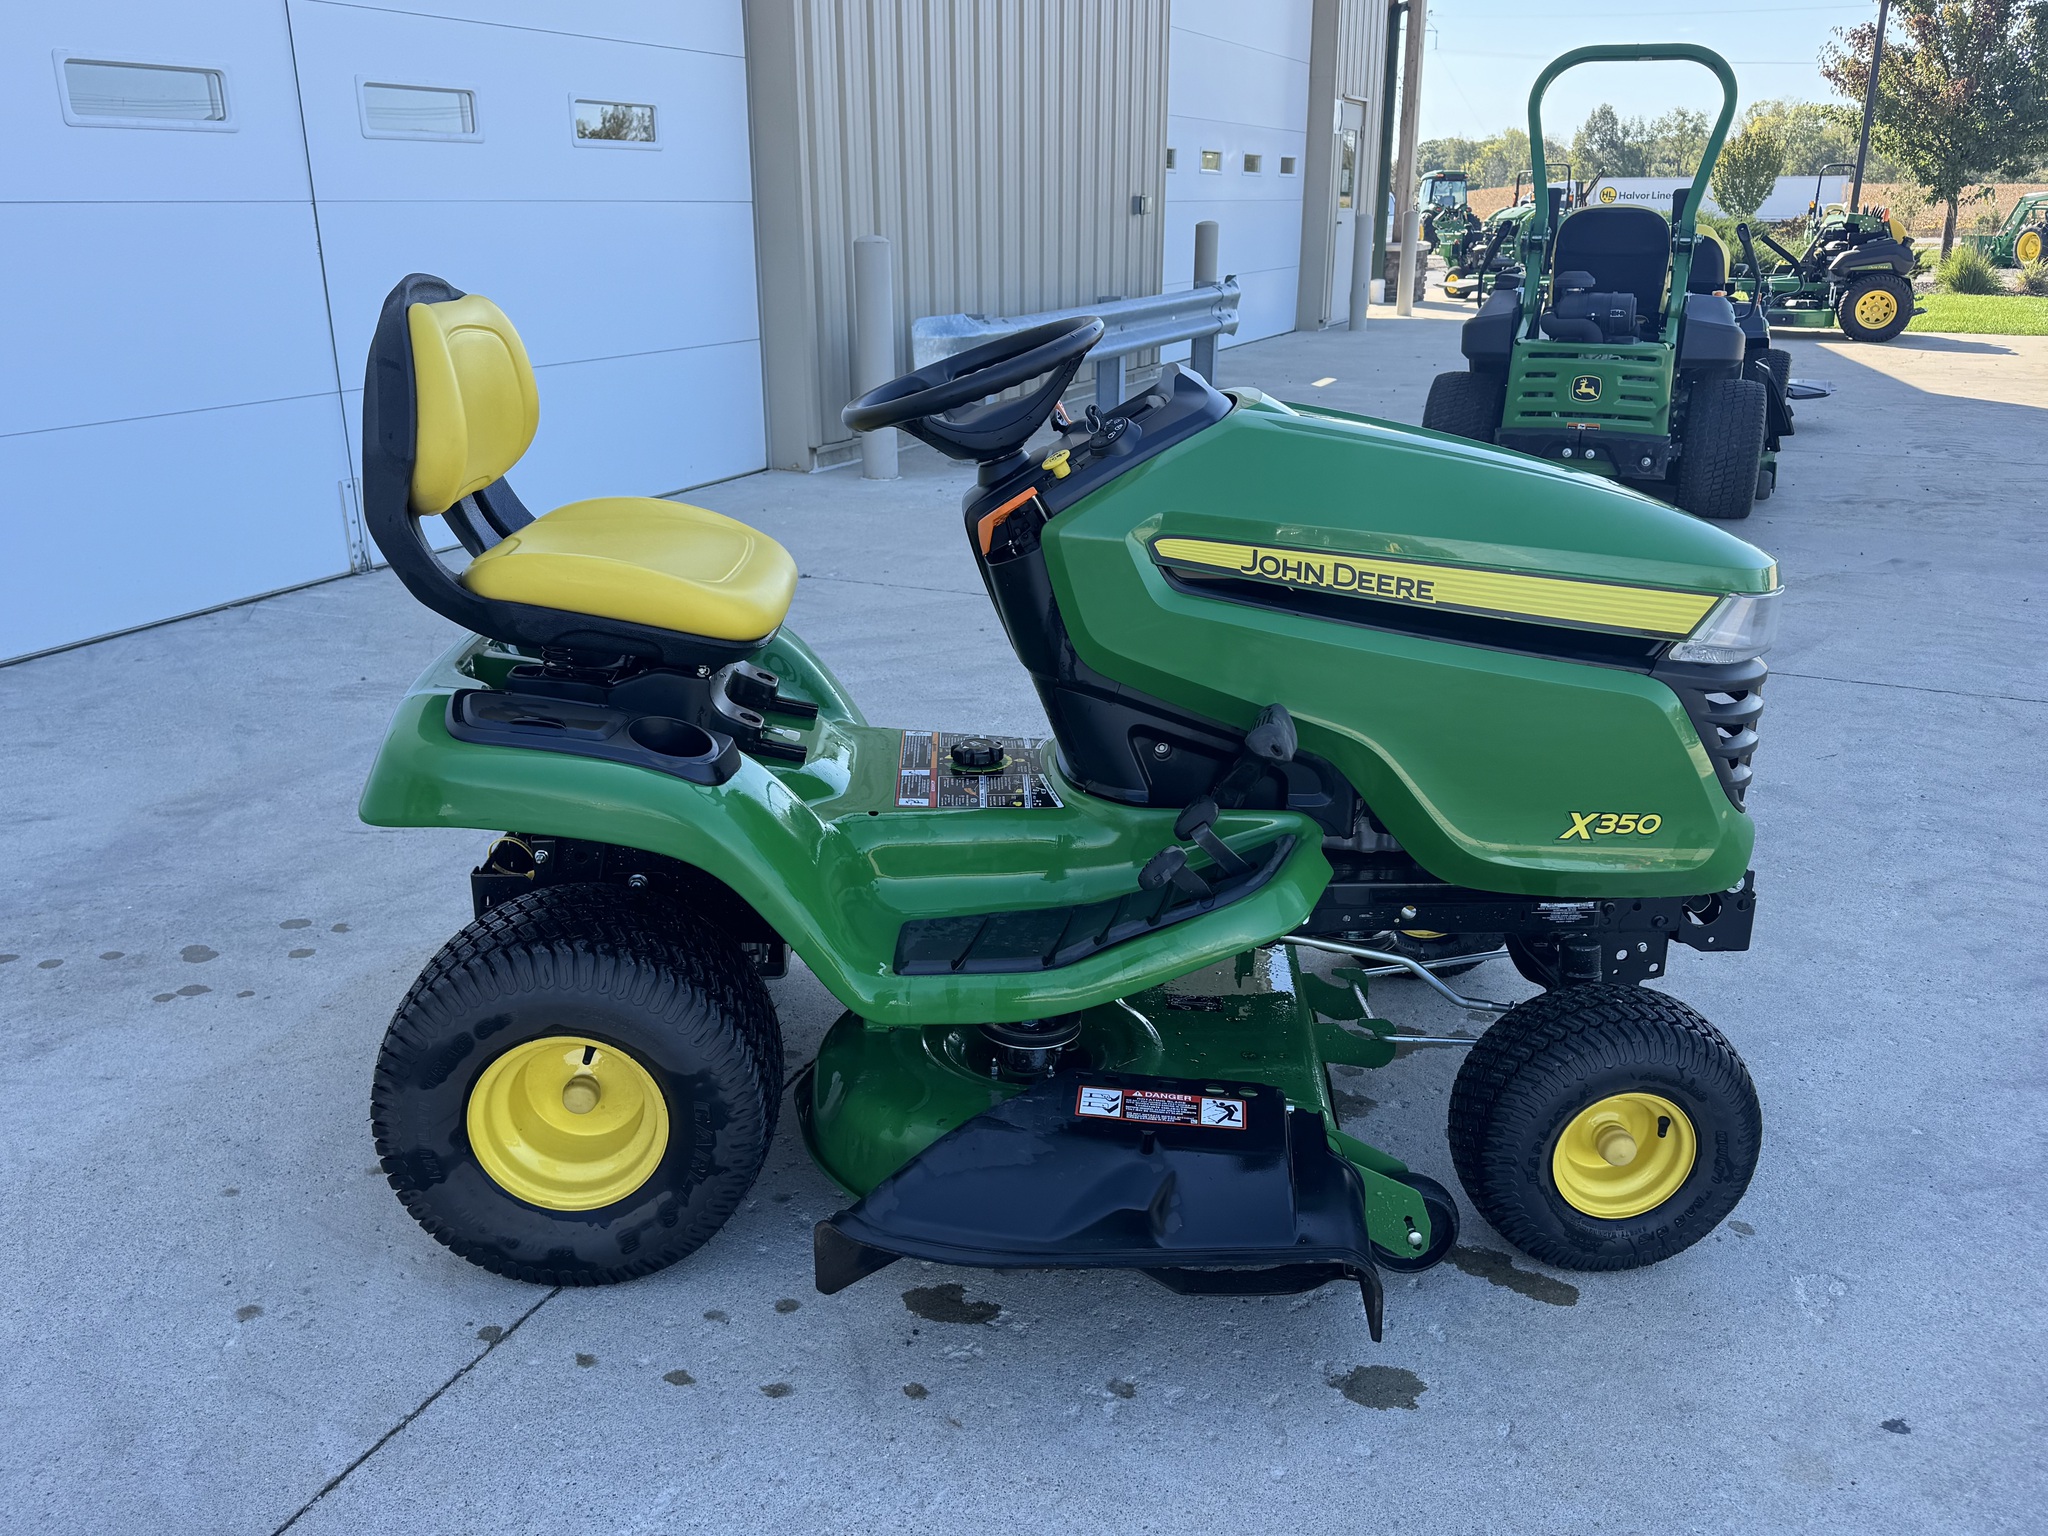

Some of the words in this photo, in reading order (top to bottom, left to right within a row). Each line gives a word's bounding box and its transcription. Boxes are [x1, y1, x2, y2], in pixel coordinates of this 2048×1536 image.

[1602, 191, 1616, 199] HL
[1619, 191, 1650, 200] Halvor
[1240, 549, 1325, 584] JOHN
[1333, 562, 1436, 601] DEERE
[1555, 811, 1662, 841] X350
[1144, 1091, 1193, 1102] DANGER
